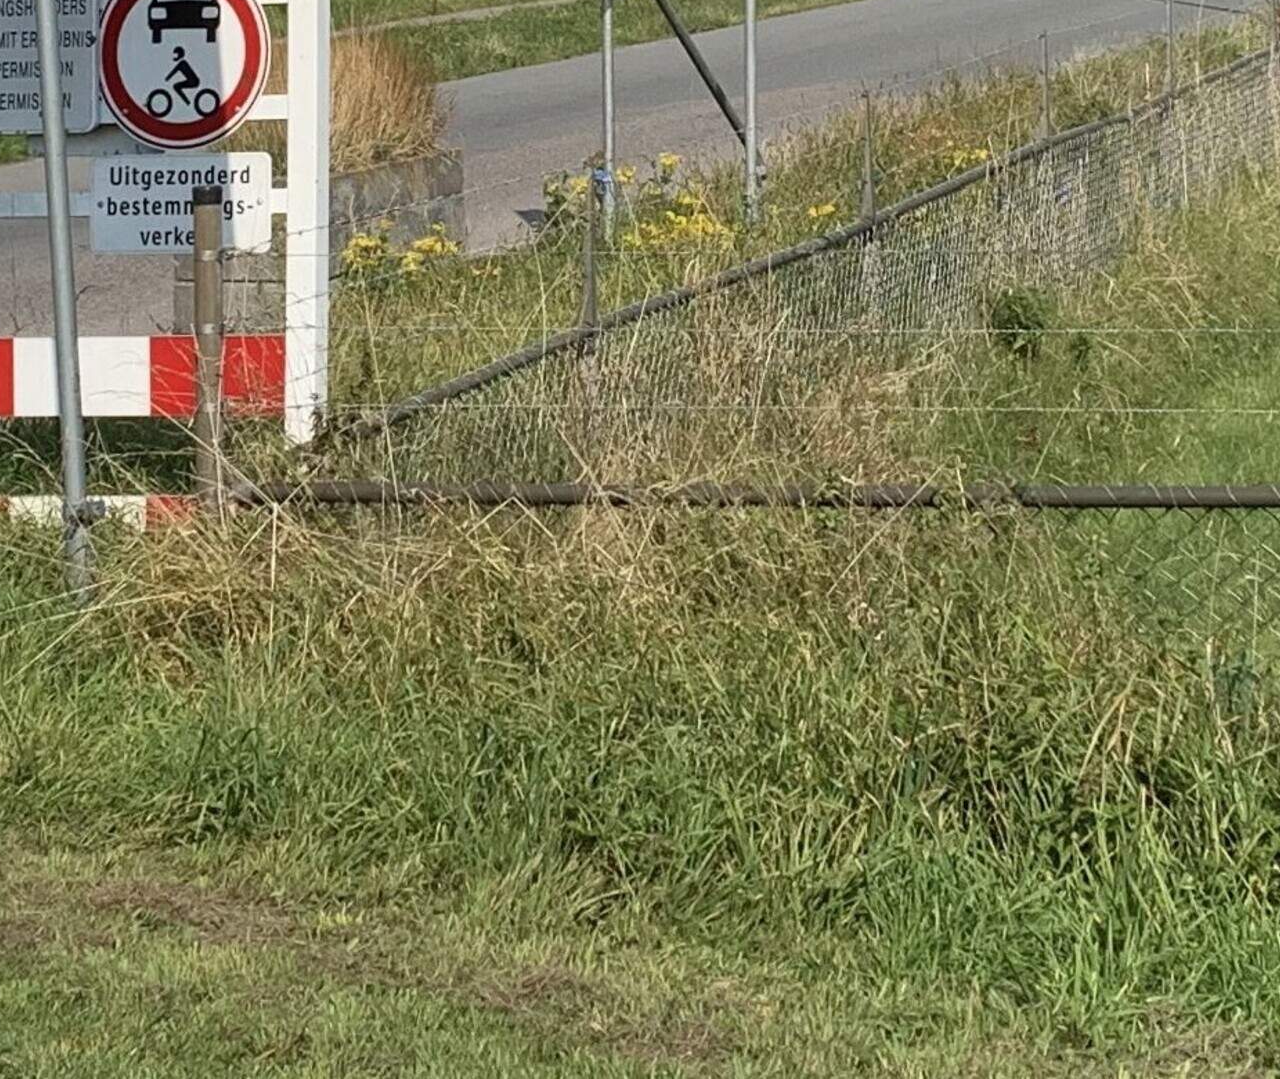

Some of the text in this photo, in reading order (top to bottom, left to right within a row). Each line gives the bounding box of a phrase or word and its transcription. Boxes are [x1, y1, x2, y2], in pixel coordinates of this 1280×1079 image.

[21, 30, 92, 48] ERBNIS
[109, 165, 251, 191] Uitgezonderd
[107, 197, 254, 220] bestemmgs-
